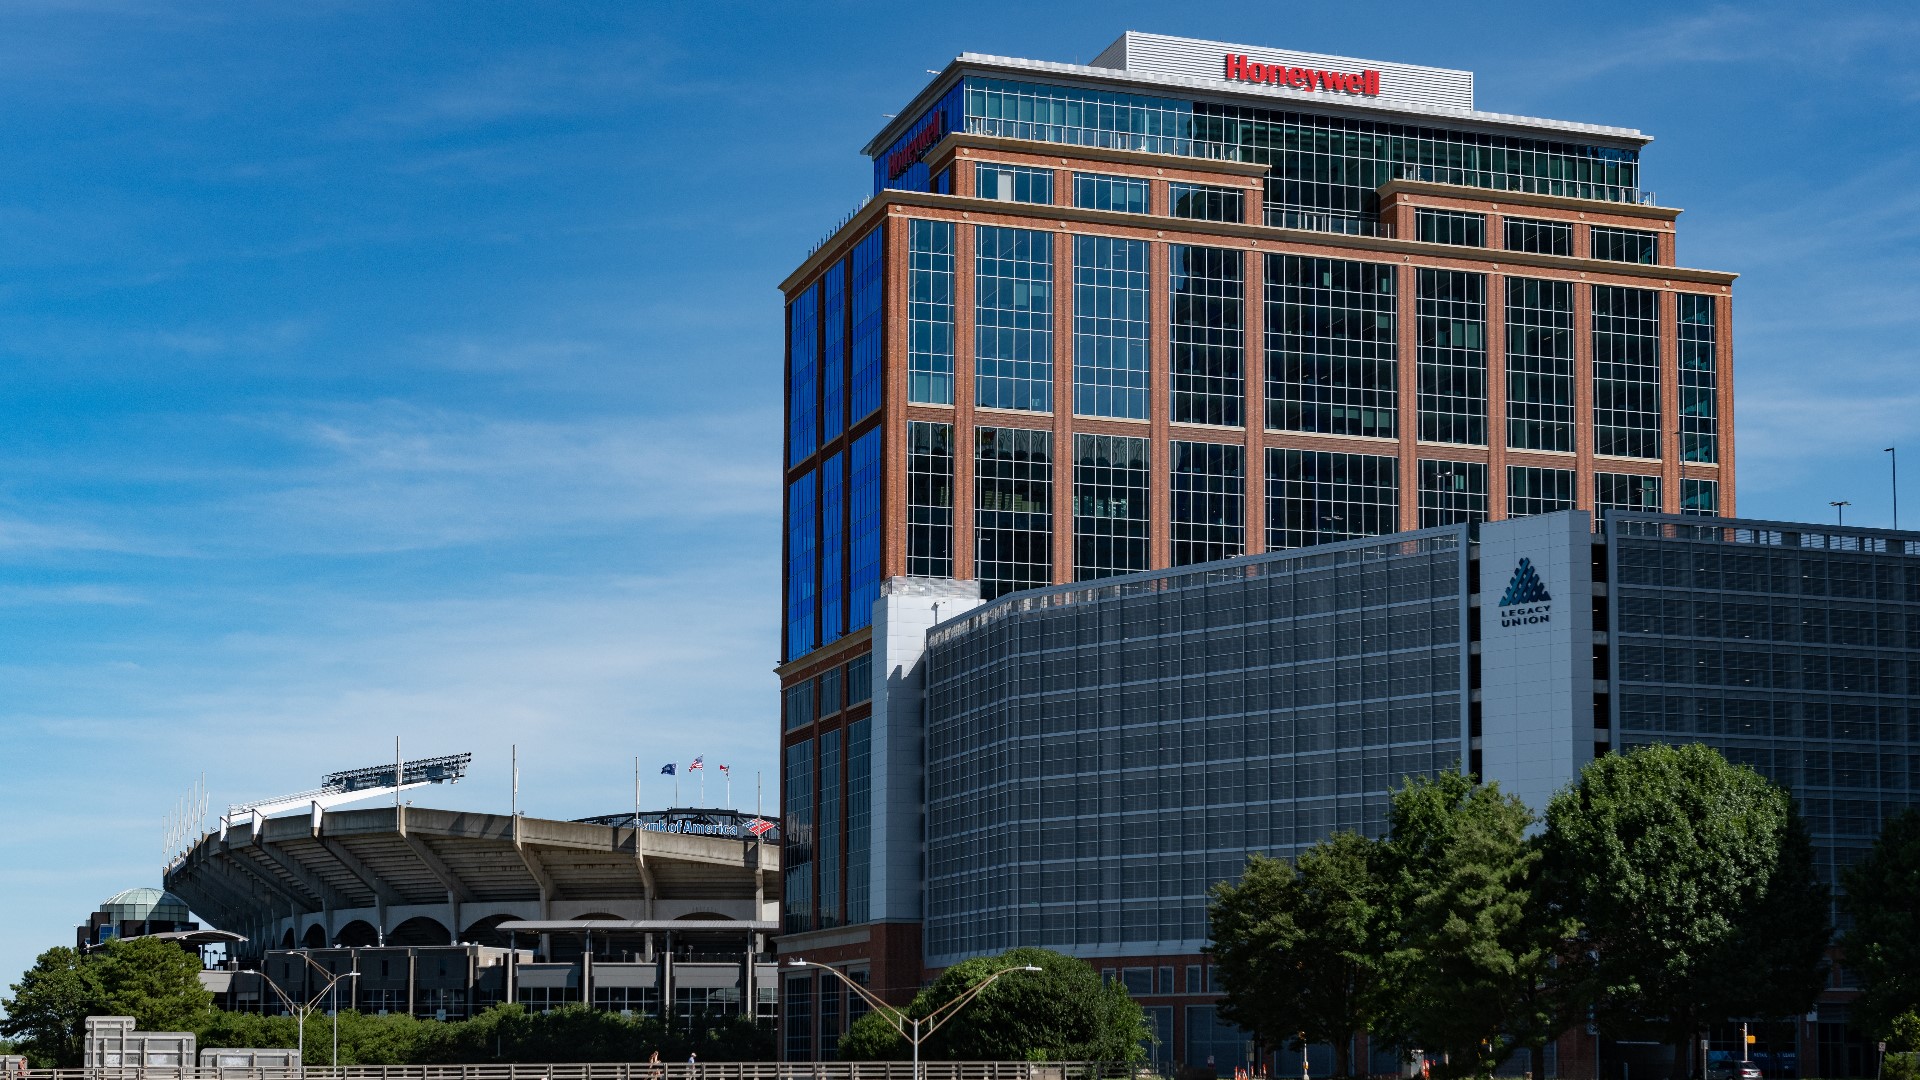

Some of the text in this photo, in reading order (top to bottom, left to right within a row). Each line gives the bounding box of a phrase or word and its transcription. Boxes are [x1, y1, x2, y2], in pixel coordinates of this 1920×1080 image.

[1225, 53, 1380, 95] Honeywell
[1501, 605, 1551, 617] LEGACY
[1501, 615, 1550, 627] UNION
[668, 819, 682, 833] of
[683, 820, 738, 836] America
